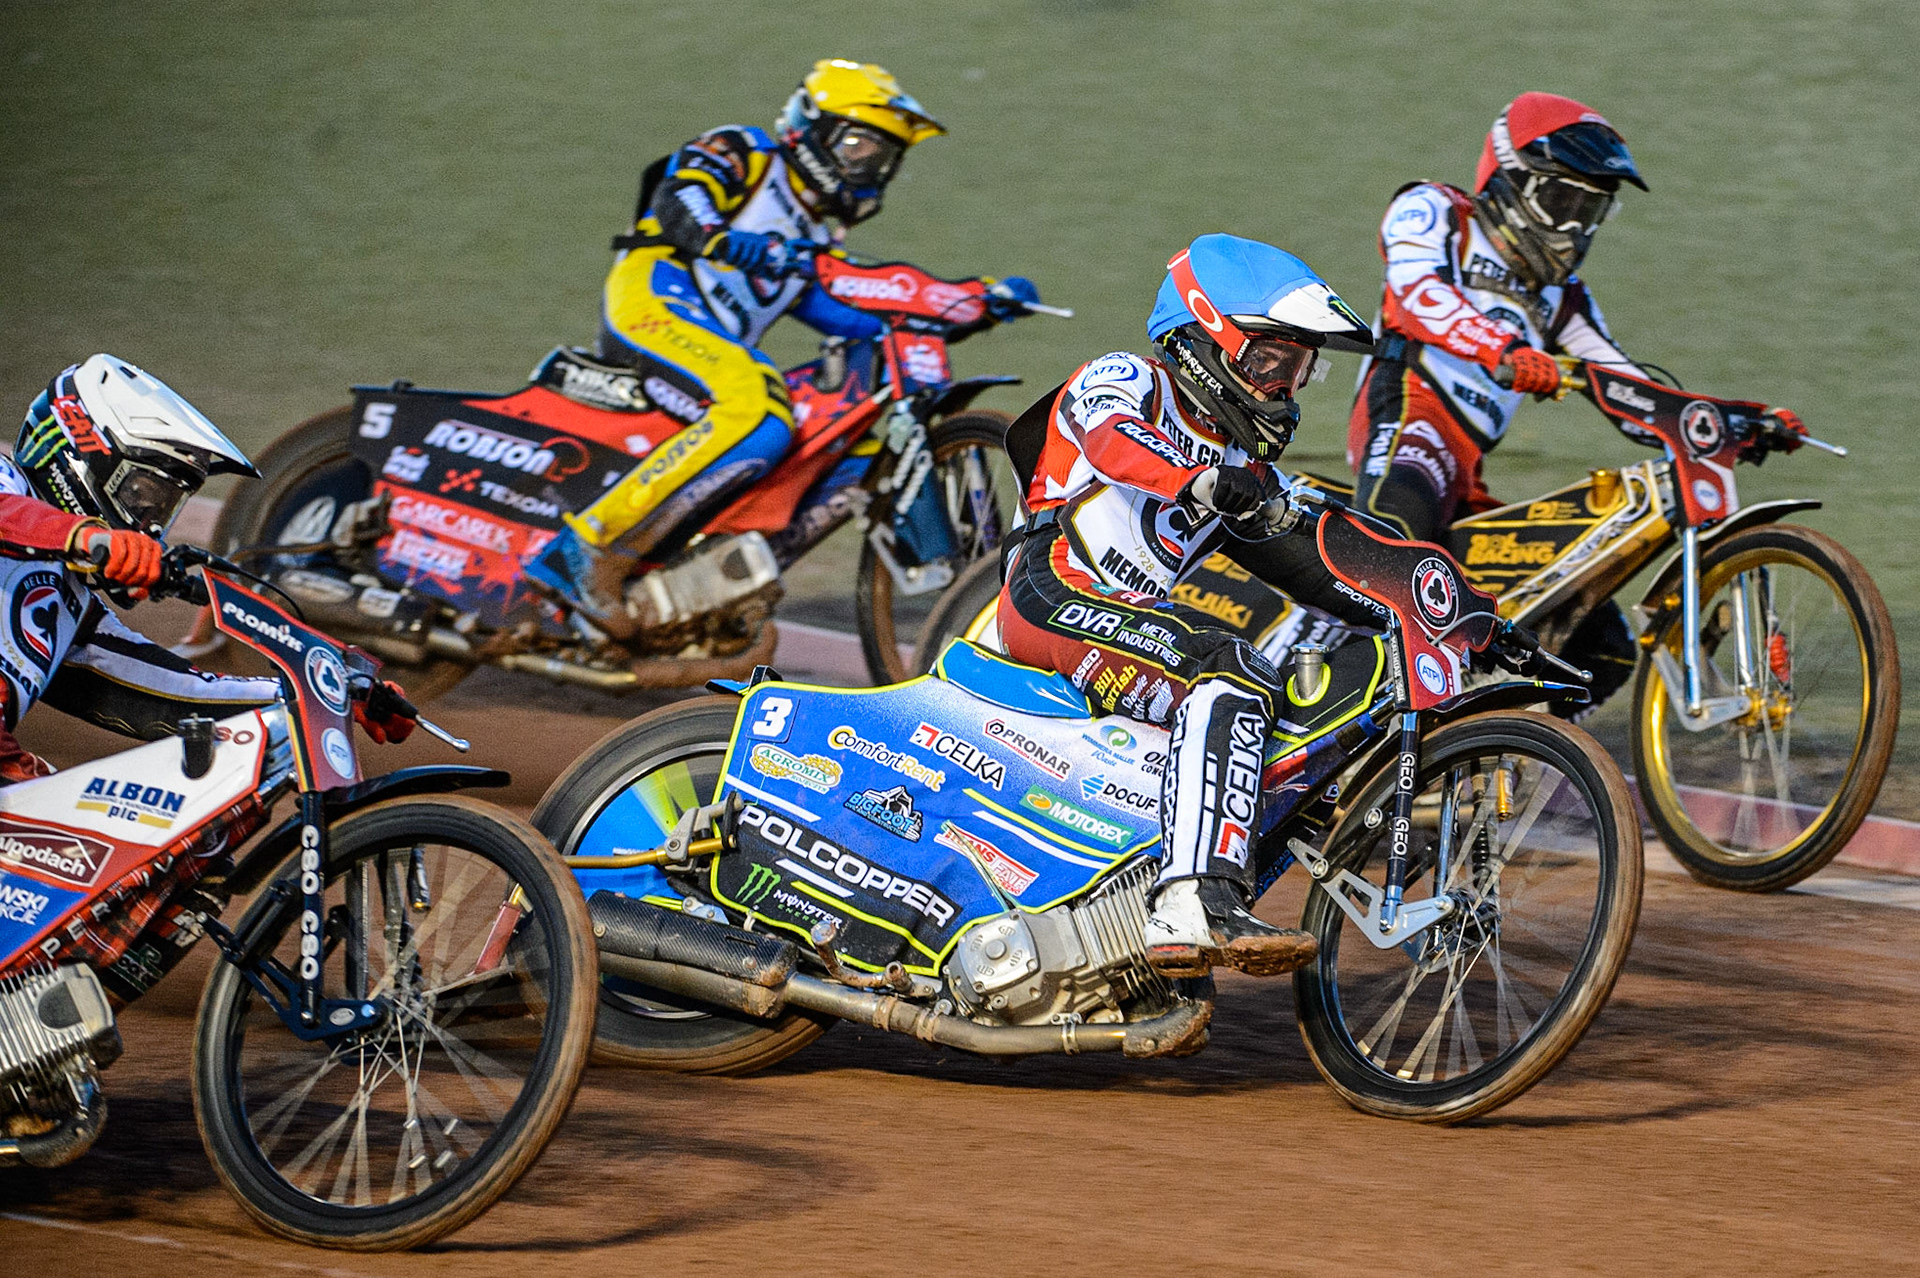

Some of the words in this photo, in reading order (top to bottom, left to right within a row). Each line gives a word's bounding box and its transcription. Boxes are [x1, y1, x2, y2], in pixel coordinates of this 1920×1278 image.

[359, 402, 397, 439] 5
[423, 420, 557, 476] ROBSON
[1417, 561, 1433, 579] BELLE
[1057, 603, 1122, 636] DVR
[1139, 621, 1178, 647] METAL
[1093, 667, 1117, 697] Bill
[1422, 665, 1441, 683] ATPI
[752, 697, 793, 737] 3
[759, 748, 832, 784] AGROMIX
[935, 734, 1005, 789] CELKA
[1002, 729, 1071, 775] PRONAR
[1226, 713, 1264, 824] CELKA
[1399, 752, 1415, 789] GEO
[84, 777, 187, 812] ALBON
[107, 804, 139, 823] plc
[849, 793, 917, 836] BIGFOOT
[1050, 801, 1129, 845] MOTOREX
[1394, 818, 1410, 856] GEO
[739, 805, 957, 928] POLCOPPER
[773, 889, 843, 929] MONSTER
